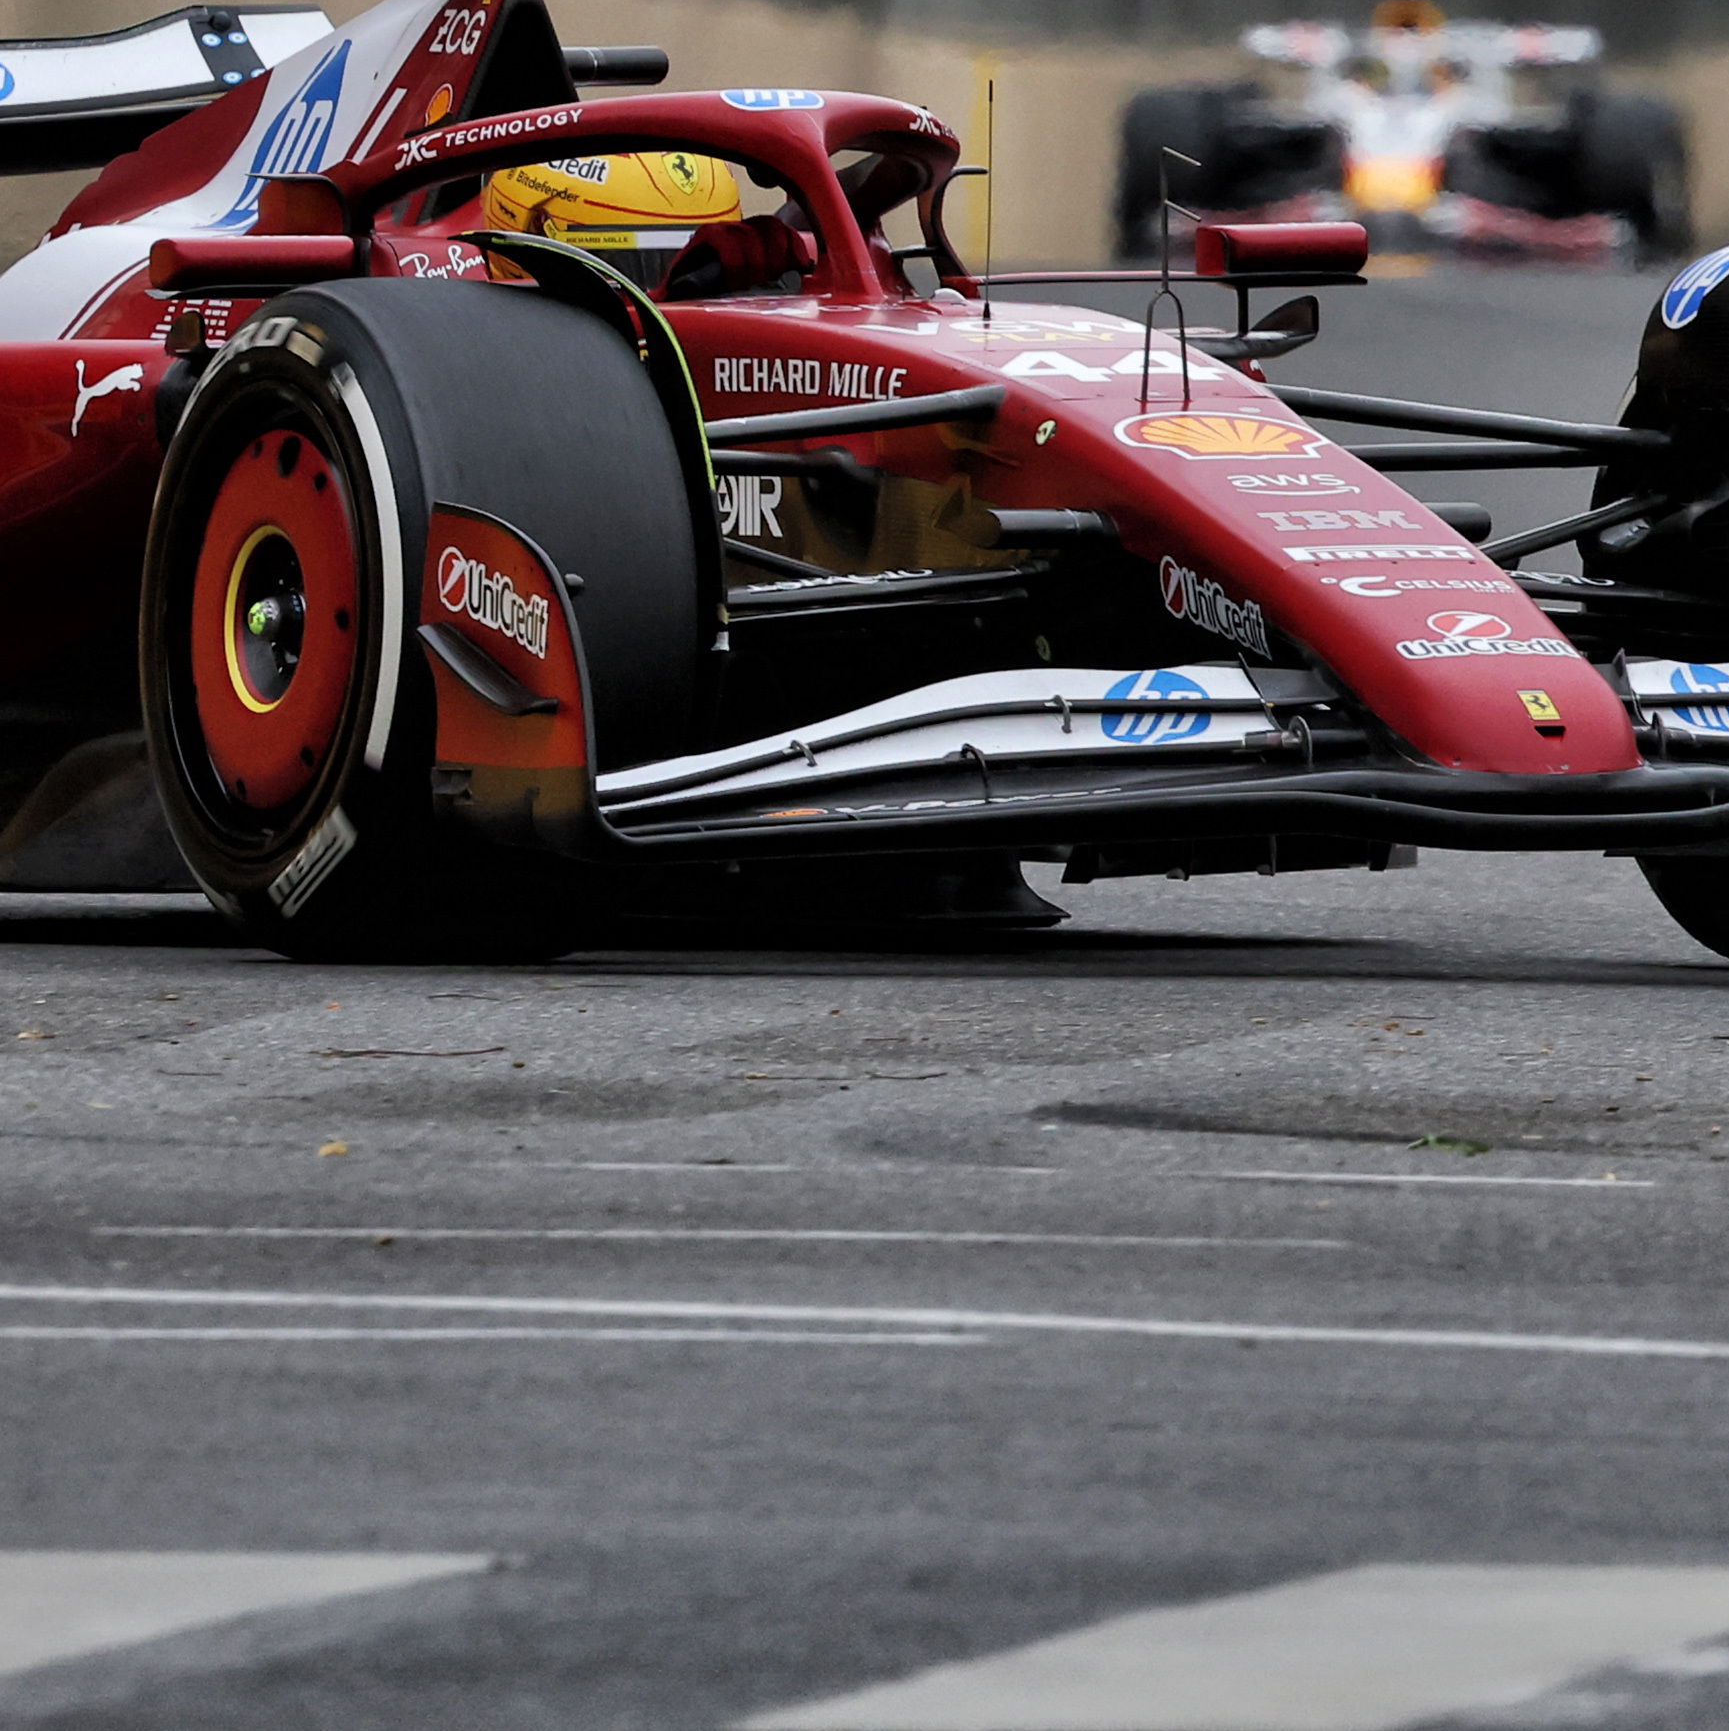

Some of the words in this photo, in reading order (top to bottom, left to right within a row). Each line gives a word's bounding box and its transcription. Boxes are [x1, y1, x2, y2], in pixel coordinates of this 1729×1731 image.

[429, 9, 485, 54] ZCG
[445, 109, 584, 147] TECHNOLOGY
[548, 157, 607, 183] Credit
[516, 170, 580, 203] Bitdefender
[714, 357, 820, 395] RICHARD
[827, 362, 907, 400] MILLE
[1227, 473, 1347, 489] aws
[1257, 510, 1424, 531] IBM
[1282, 544, 1476, 562] PIRELLI
[1393, 579, 1513, 591] CELSIUS
[468, 560, 548, 657] UniCredit
[1182, 568, 1268, 657] UniCredit
[1398, 636, 1577, 659] UniCredit
